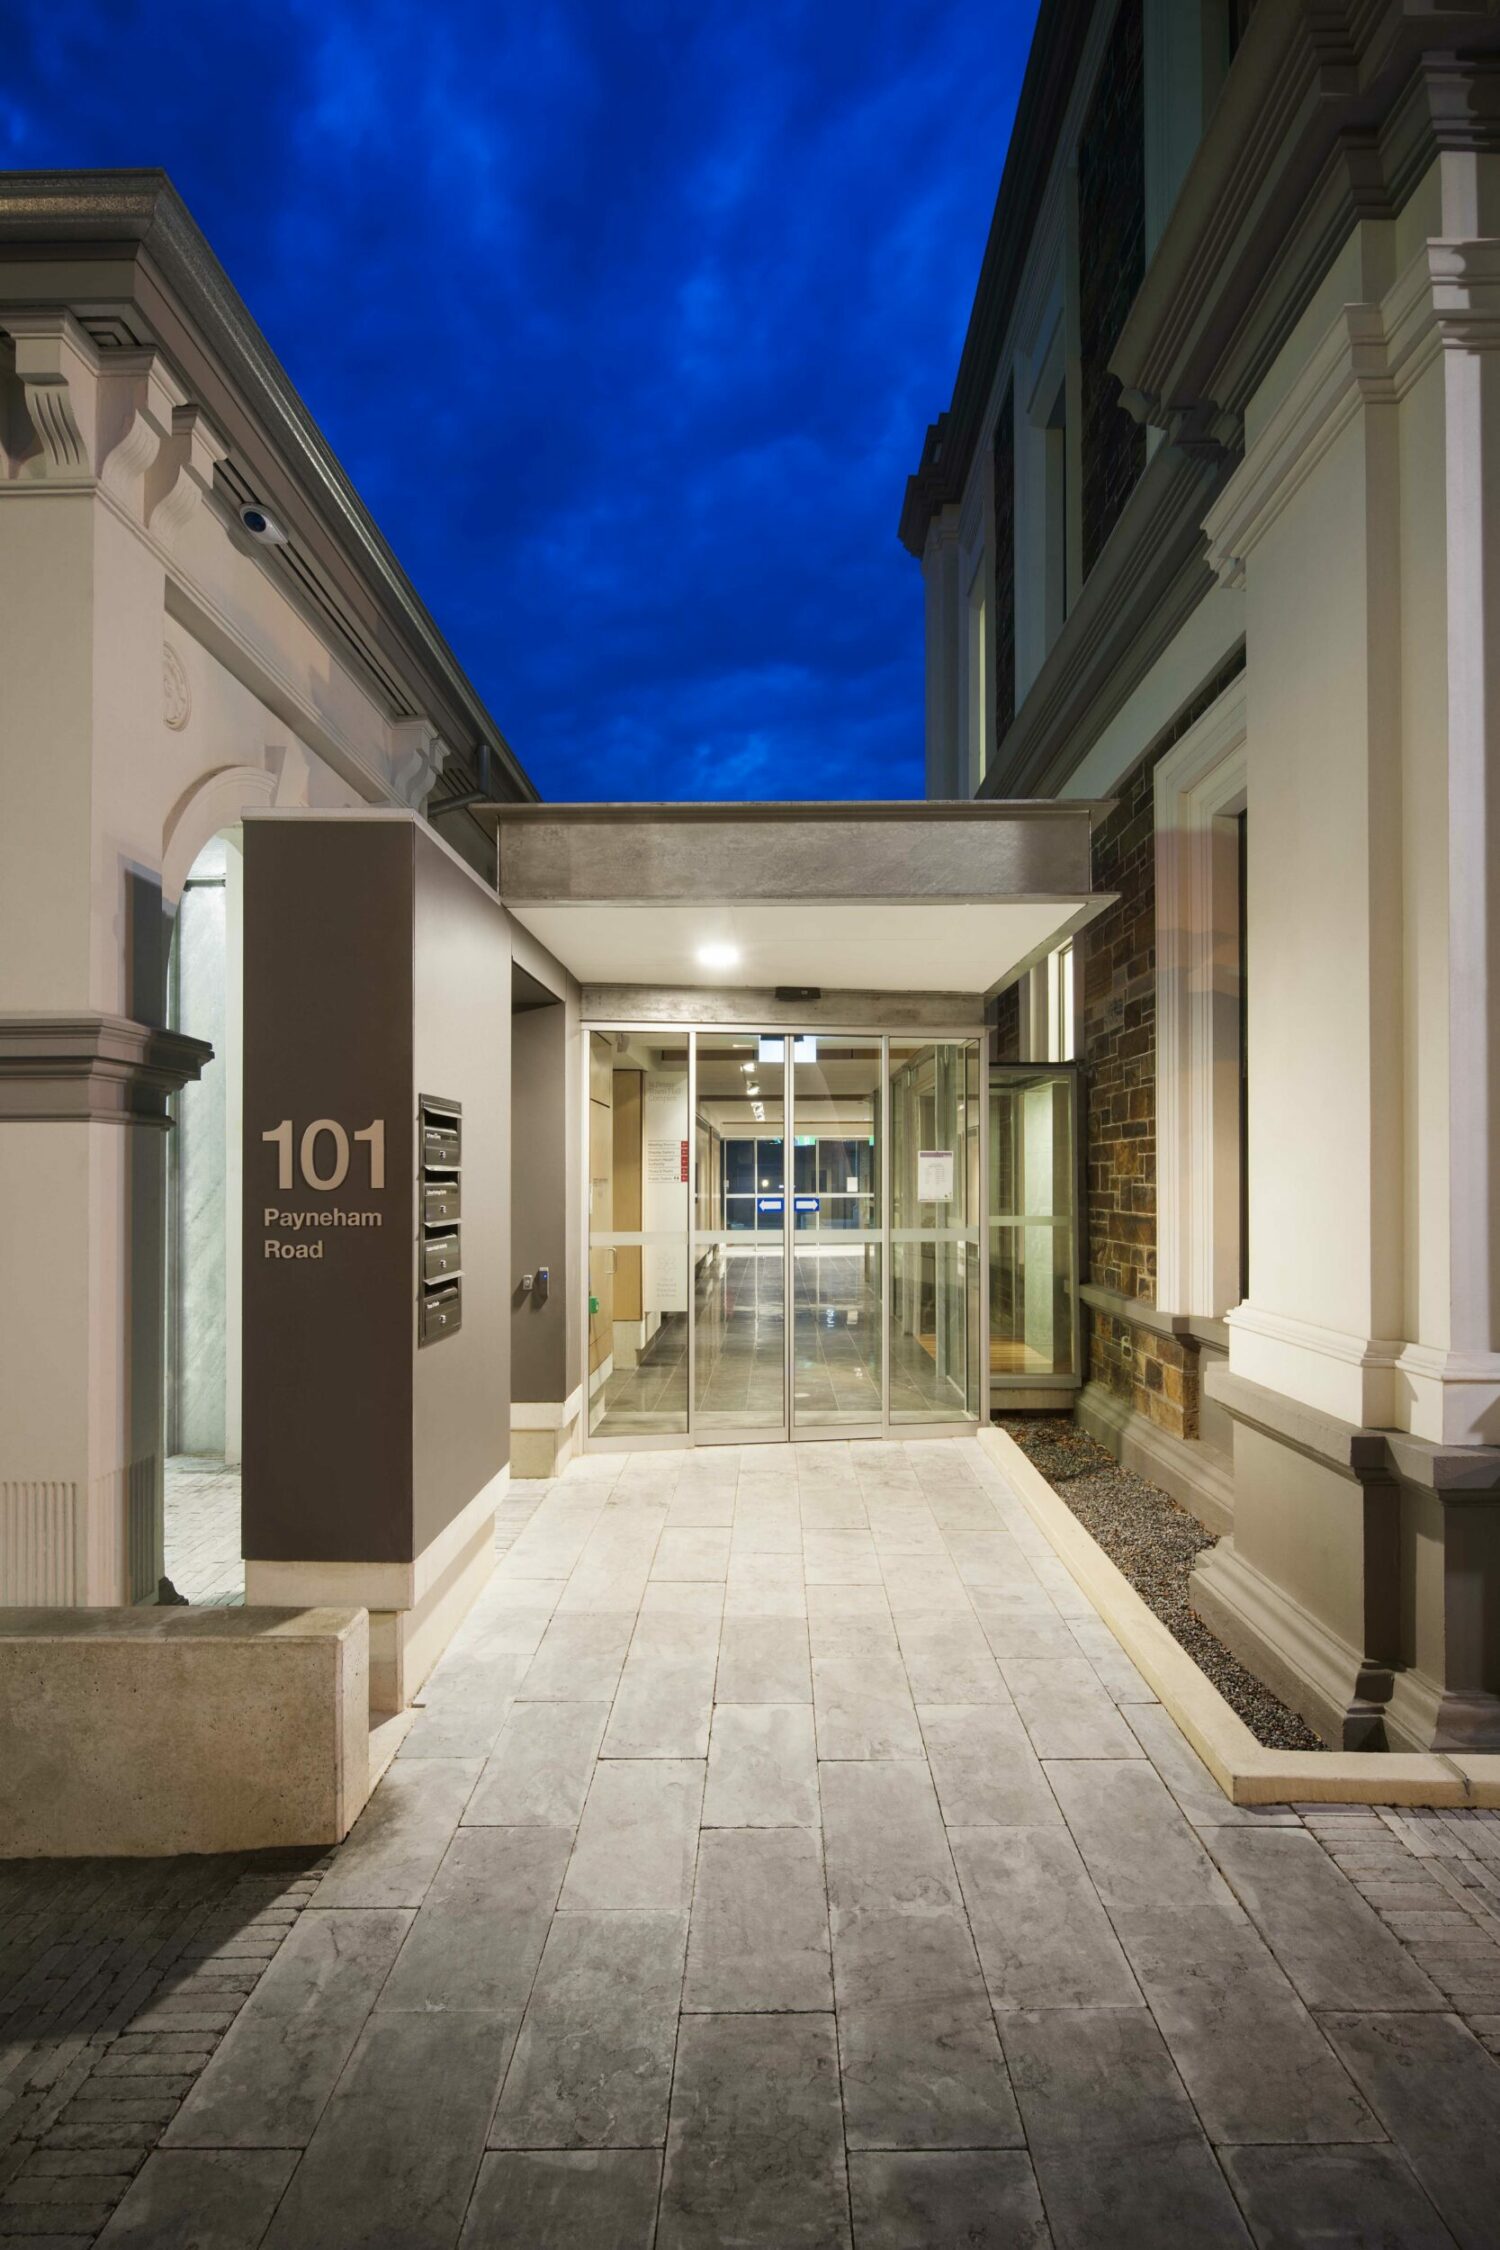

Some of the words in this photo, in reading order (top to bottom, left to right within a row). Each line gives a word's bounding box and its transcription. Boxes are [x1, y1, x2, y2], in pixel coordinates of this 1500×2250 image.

[262, 1118, 385, 1191] 101
[264, 1208, 382, 1230] Payneham
[264, 1240, 323, 1259] Road
